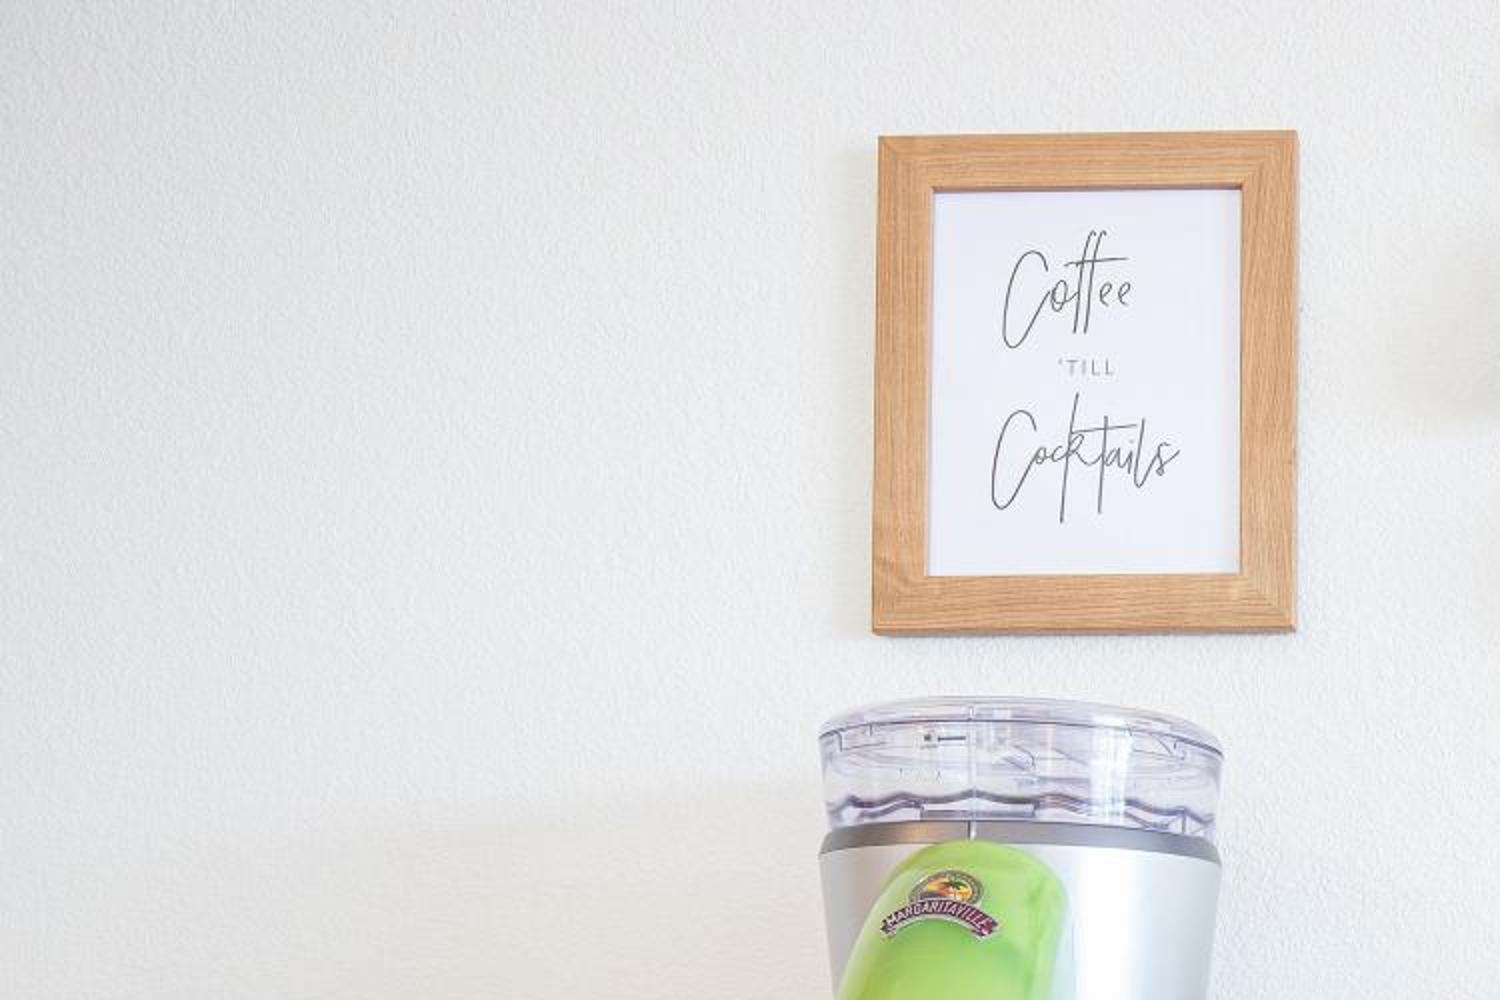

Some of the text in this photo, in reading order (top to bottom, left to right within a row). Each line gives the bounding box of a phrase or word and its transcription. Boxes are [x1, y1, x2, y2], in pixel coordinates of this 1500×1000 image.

[1002, 229, 1133, 349] Coffee
[991, 392, 1181, 524] Cocktails
[887, 900, 991, 931] MARGARITAVILLE
